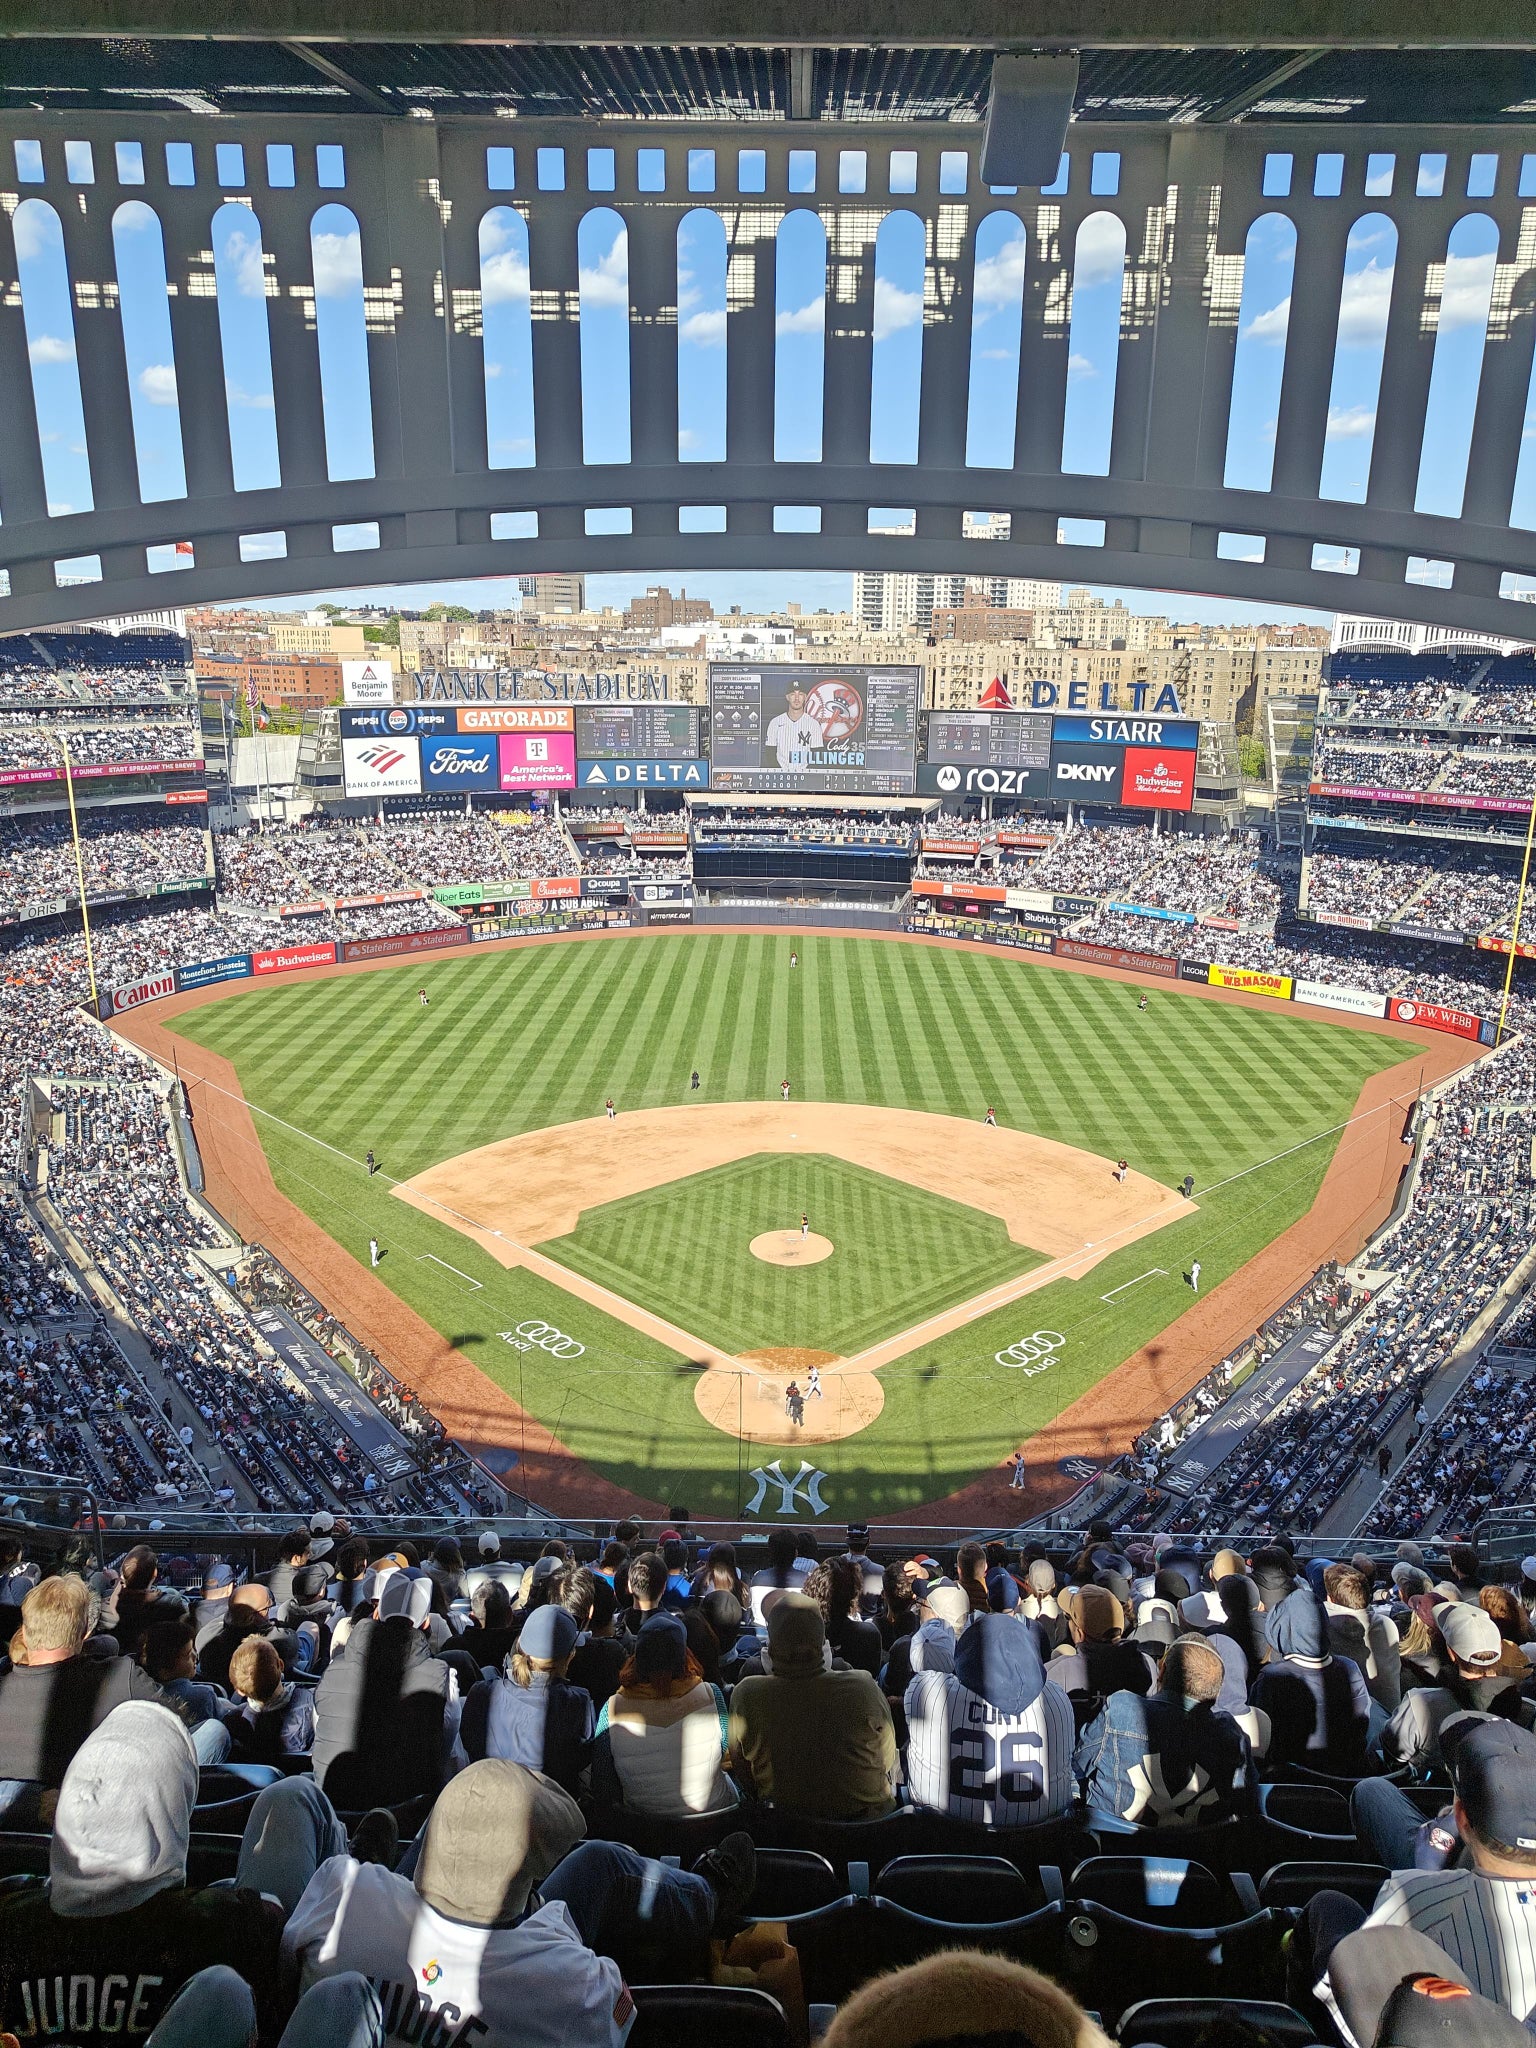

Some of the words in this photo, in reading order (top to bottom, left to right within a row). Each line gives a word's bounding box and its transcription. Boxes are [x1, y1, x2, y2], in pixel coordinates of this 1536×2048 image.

[351, 681, 388, 690] Benjamin
[413, 671, 524, 700] YANKEE
[543, 672, 670, 701] STADIUM
[1031, 680, 1182, 713] DELTA
[351, 717, 379, 725] PEPSI
[417, 716, 445, 724] PEPSI
[464, 710, 569, 728] GATORADE
[1089, 720, 1163, 743] STARR
[827, 737, 850, 756] Cody
[851, 741, 866, 752] 35
[129, 763, 160, 771] SPREADIN'
[175, 761, 197, 769] BREWS
[429, 747, 489, 776] Ford
[511, 765, 564, 775] America's
[615, 764, 701, 781] DELTA
[1057, 763, 1117, 782] DKNY
[347, 781, 368, 789] BANK
[381, 779, 418, 787] AMERICA
[502, 774, 521, 783] Best
[524, 773, 573, 783] Network
[966, 769, 1029, 794] razr
[1136, 775, 1184, 787] Budweiser
[1320, 786, 1341, 794] START
[1341, 788, 1376, 797] SPREADIN'
[1391, 792, 1416, 800] BREWS
[1447, 797, 1477, 806] DUNKIN'
[1482, 800, 1507, 808] START
[1507, 802, 1534, 810] SPREA
[635, 835, 652, 843] King's
[1002, 834, 1021, 842] King's
[1021, 836, 1051, 844] Hawaiian
[925, 841, 945, 849] King's
[944, 843, 975, 851] Hawaiian
[161, 883, 182, 893] Poland
[182, 881, 203, 892] Spring
[597, 879, 621, 890] coupa
[459, 890, 481, 899] Eats
[551, 899, 558, 911] A
[560, 897, 579, 910] SUB
[580, 895, 610, 908] ABOVE
[1069, 902, 1094, 912] CLEAR
[28, 903, 57, 918] ORIS
[1025, 912, 1056, 925] StubHub
[1318, 913, 1336, 922] Parts
[1336, 914, 1369, 927] Authority
[527, 925, 554, 935] StubHub
[582, 921, 604, 930] STARR
[474, 931, 499, 942] StubHub
[500, 928, 526, 937] StubHub
[937, 929, 959, 938] STARR
[1391, 924, 1433, 939] Montefiore
[1433, 931, 1465, 943] Einstein
[995, 938, 1015, 946] StubHub
[1015, 941, 1033, 949] StubHub
[1033, 944, 1051, 952] StubHub
[179, 967, 216, 980] Montefiore
[216, 960, 247, 972] Einstein
[1183, 966, 1208, 977] LEGORA
[113, 976, 174, 1009] Canon
[1297, 987, 1318, 998] BANK
[1329, 994, 1366, 1007] AMERICA
[1417, 1005, 1438, 1019] F.W.
[1441, 1011, 1472, 1028] WEBB
[495, 1331, 535, 1354] Audi
[1023, 1355, 1061, 1378] Audi
[305, 1373, 343, 1400] Yankee
[333, 1399, 363, 1428] Stadium
[1223, 1414, 1249, 1431] New
[1237, 1398, 1264, 1420] York
[1253, 1376, 1287, 1405] Yankees
[749, 1459, 830, 1516] NY
[949, 1727, 1044, 1802] 26
[14, 1974, 164, 2037] JUDGE
[366, 1975, 489, 2048] UDGE
